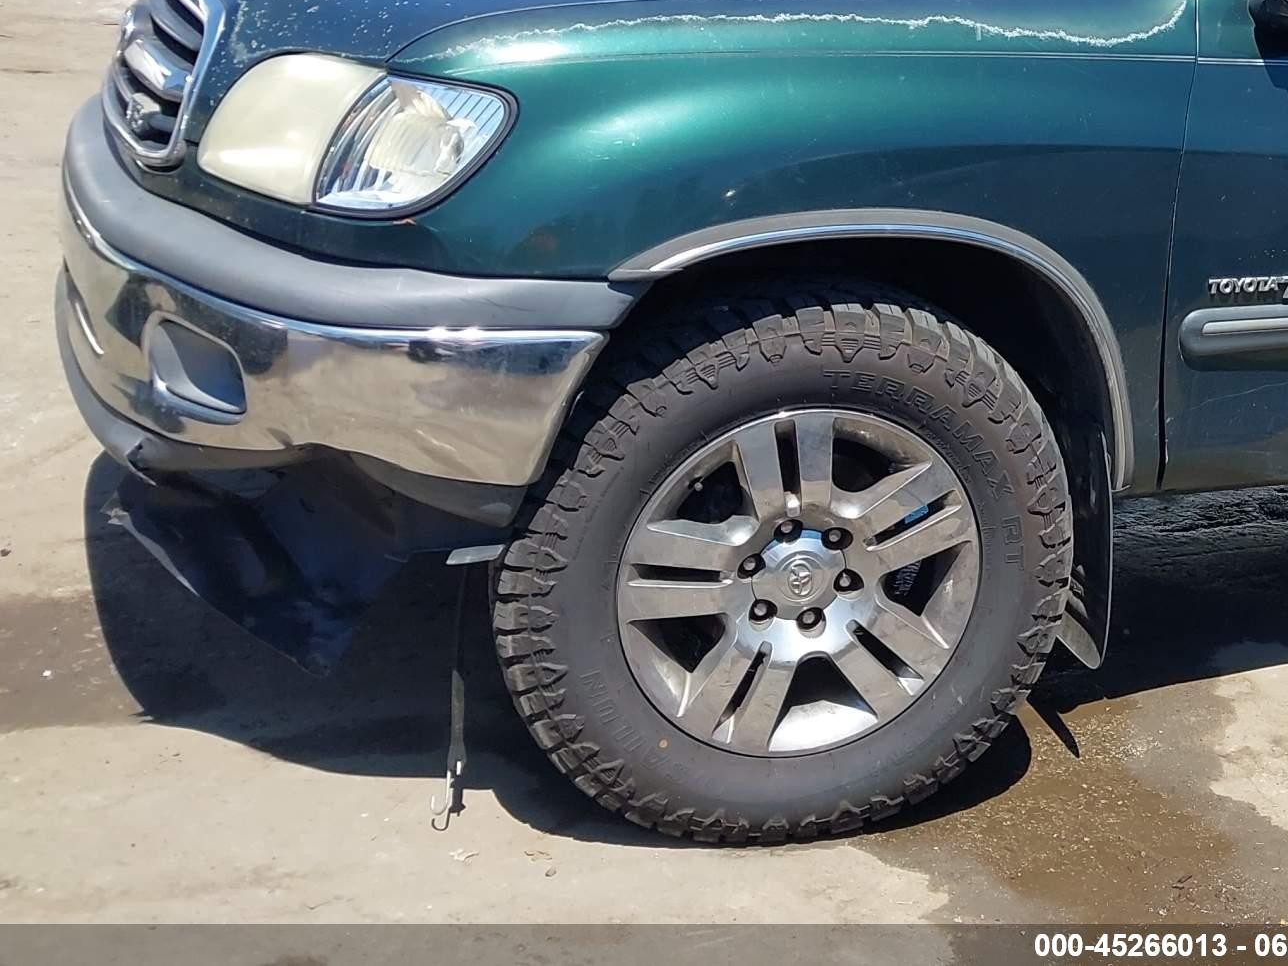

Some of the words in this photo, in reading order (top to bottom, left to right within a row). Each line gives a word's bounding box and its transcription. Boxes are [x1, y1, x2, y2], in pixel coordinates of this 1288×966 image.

[1209, 276, 1279, 295] TOYOTA
[823, 369, 1014, 500] TERRAMAX
[1002, 515, 1025, 571] RT
